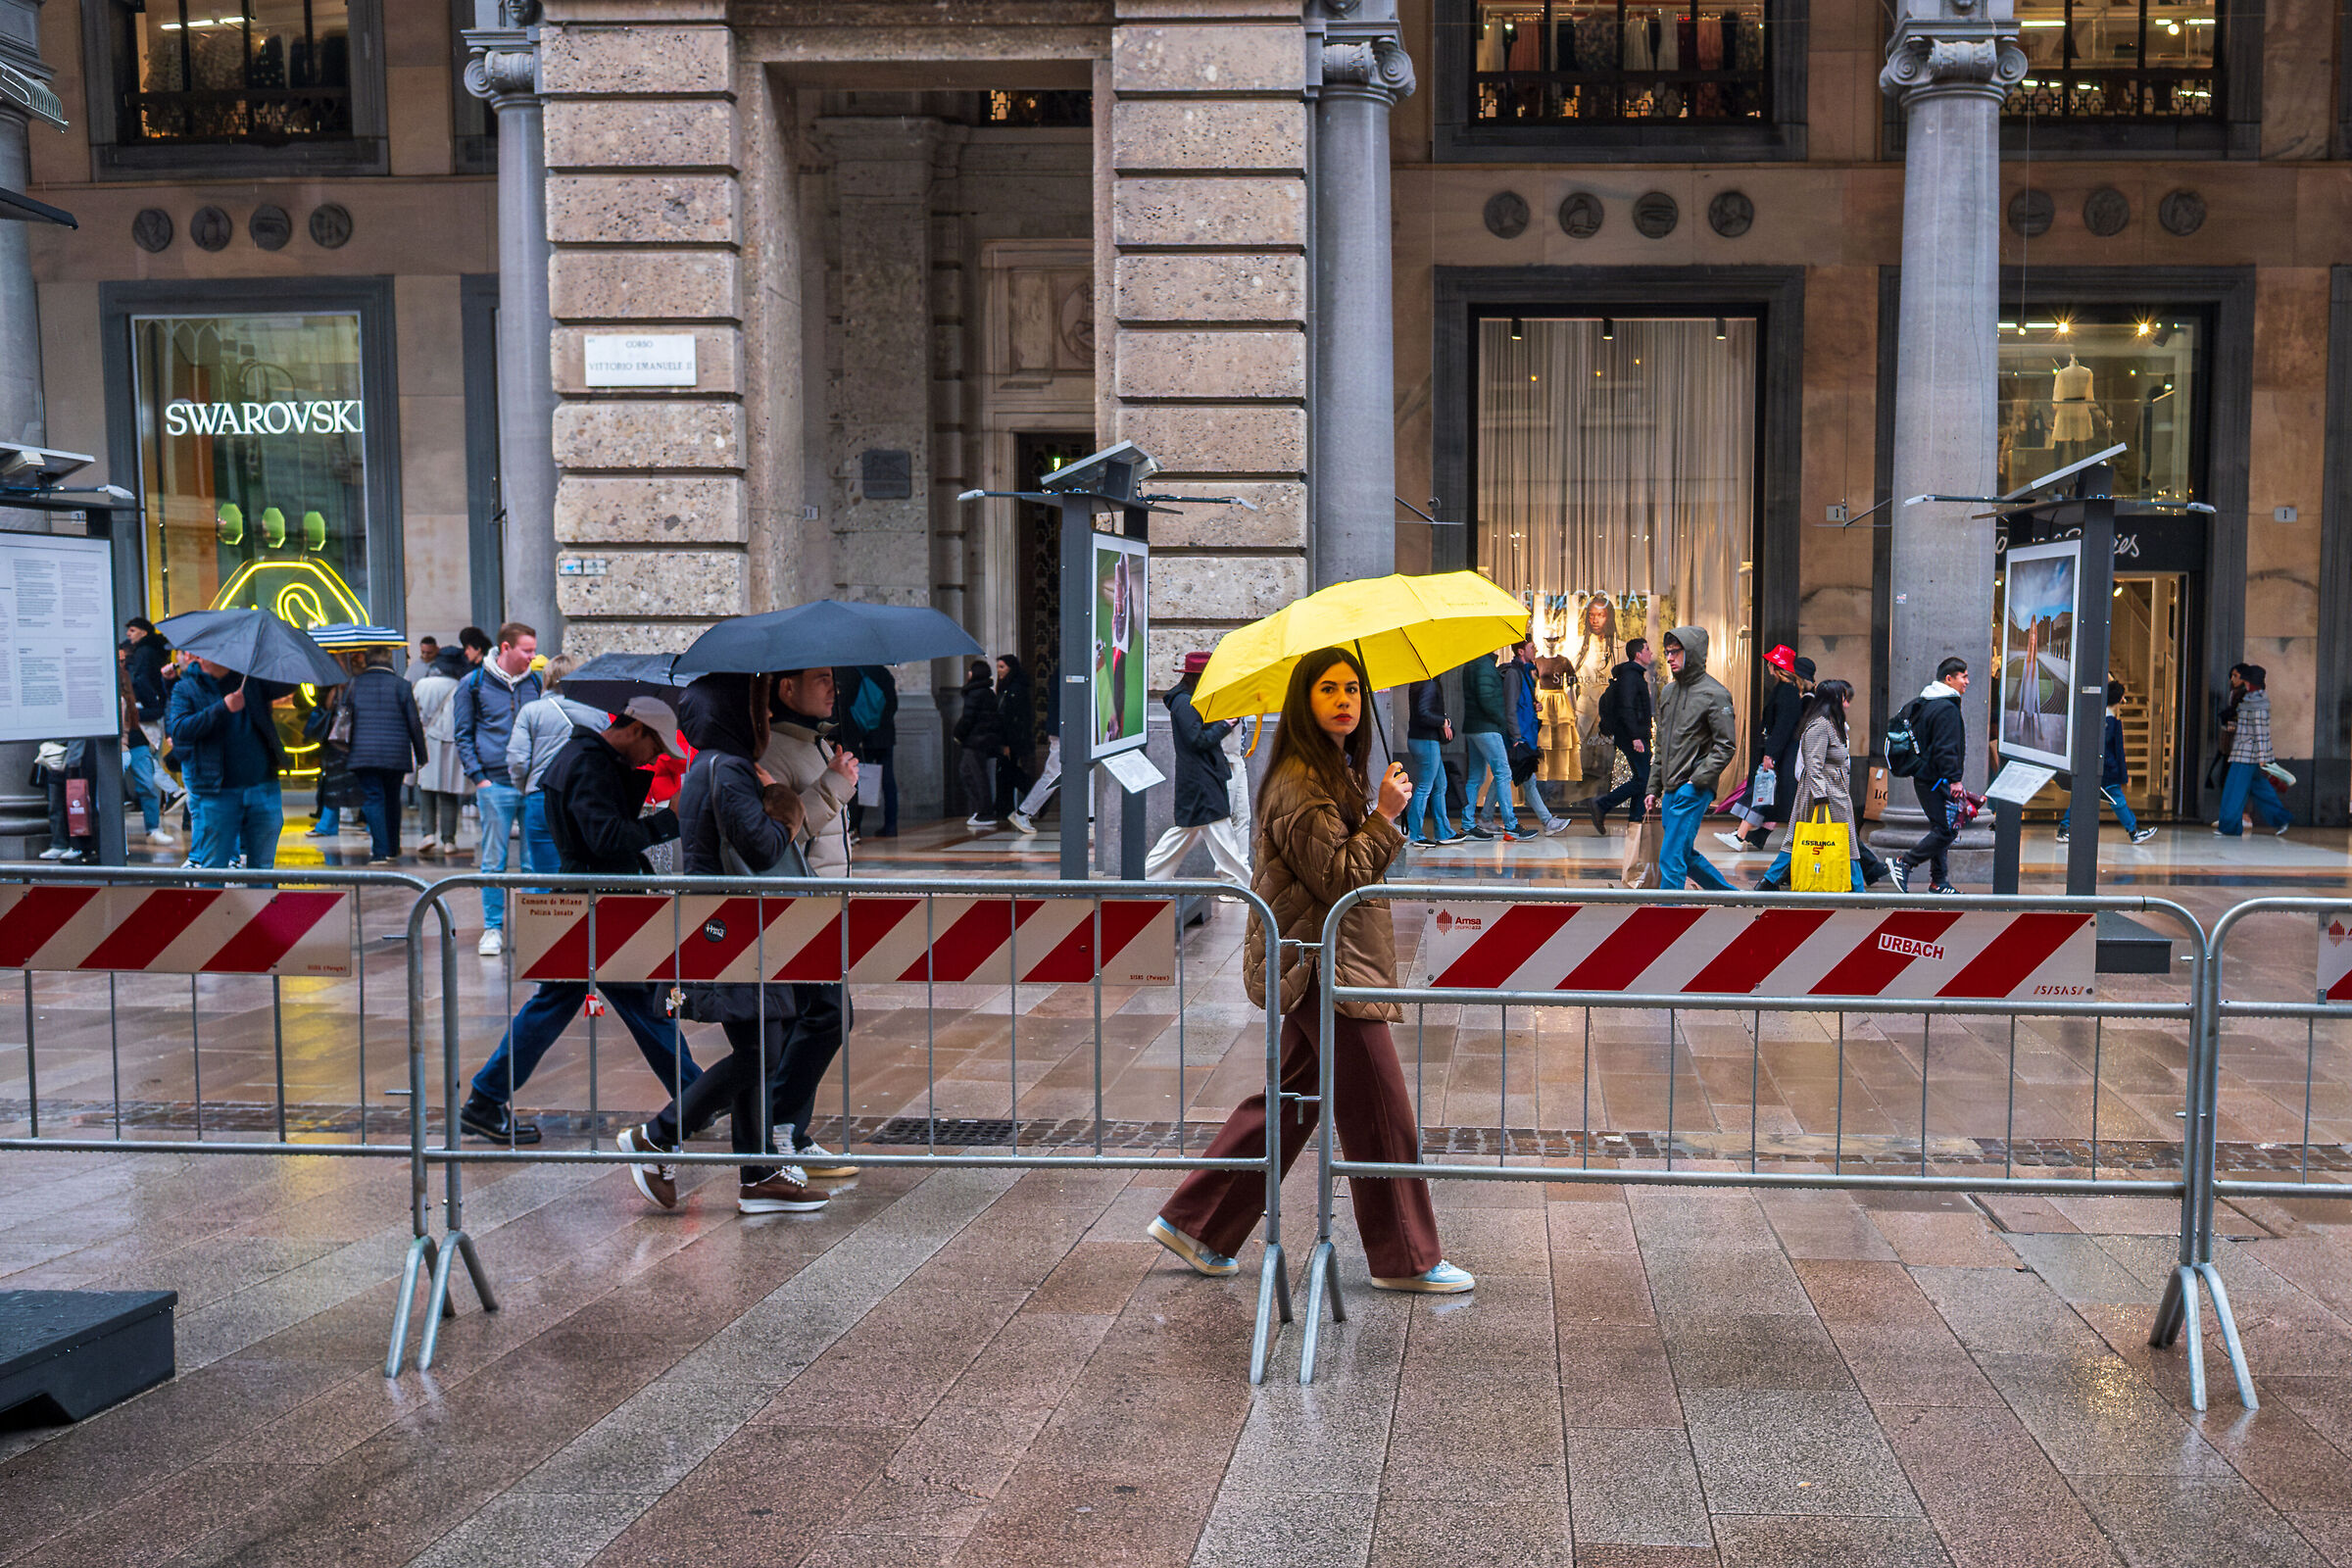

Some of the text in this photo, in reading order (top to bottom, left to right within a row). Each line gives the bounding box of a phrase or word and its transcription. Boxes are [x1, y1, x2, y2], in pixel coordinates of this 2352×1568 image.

[625, 340, 654, 349] CORSO
[588, 361, 633, 370] VITTORIO
[636, 361, 682, 370] EMANUELE
[1454, 916, 1482, 925] Amsa
[1882, 935, 1944, 960] URBACH
